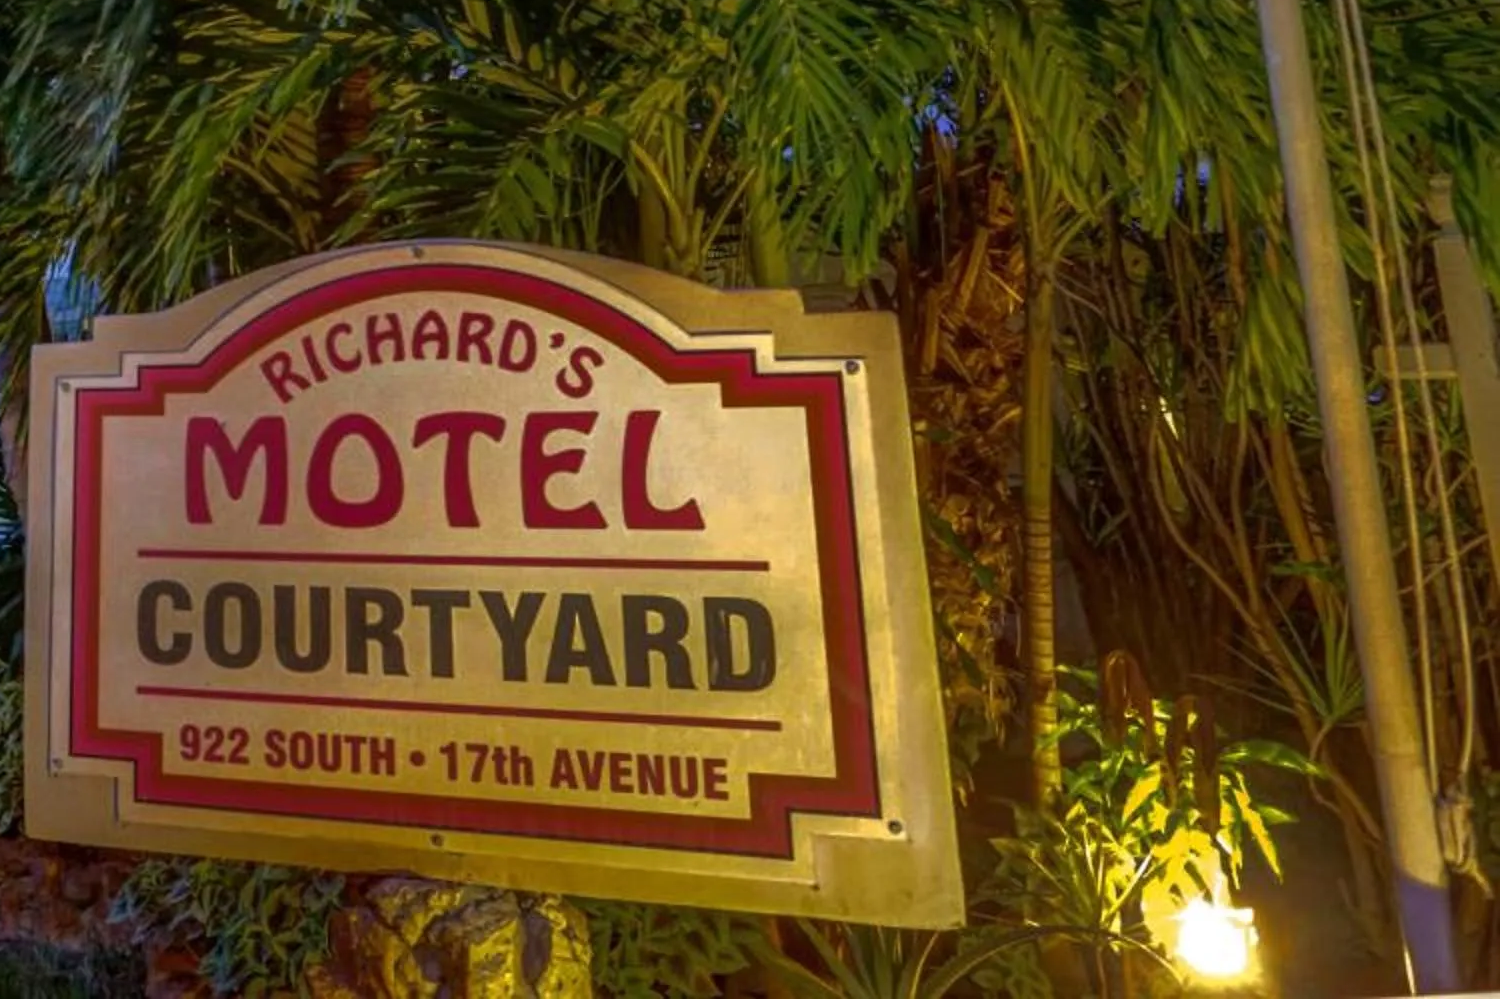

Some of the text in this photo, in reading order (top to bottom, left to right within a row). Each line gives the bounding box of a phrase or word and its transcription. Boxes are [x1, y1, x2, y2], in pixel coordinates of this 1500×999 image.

[260, 310, 605, 403] RICHARD'S
[183, 410, 706, 530] MOTEL
[136, 579, 777, 692] COURTYARD
[179, 724, 730, 800] 922 SOUTH 17th AVENUE
